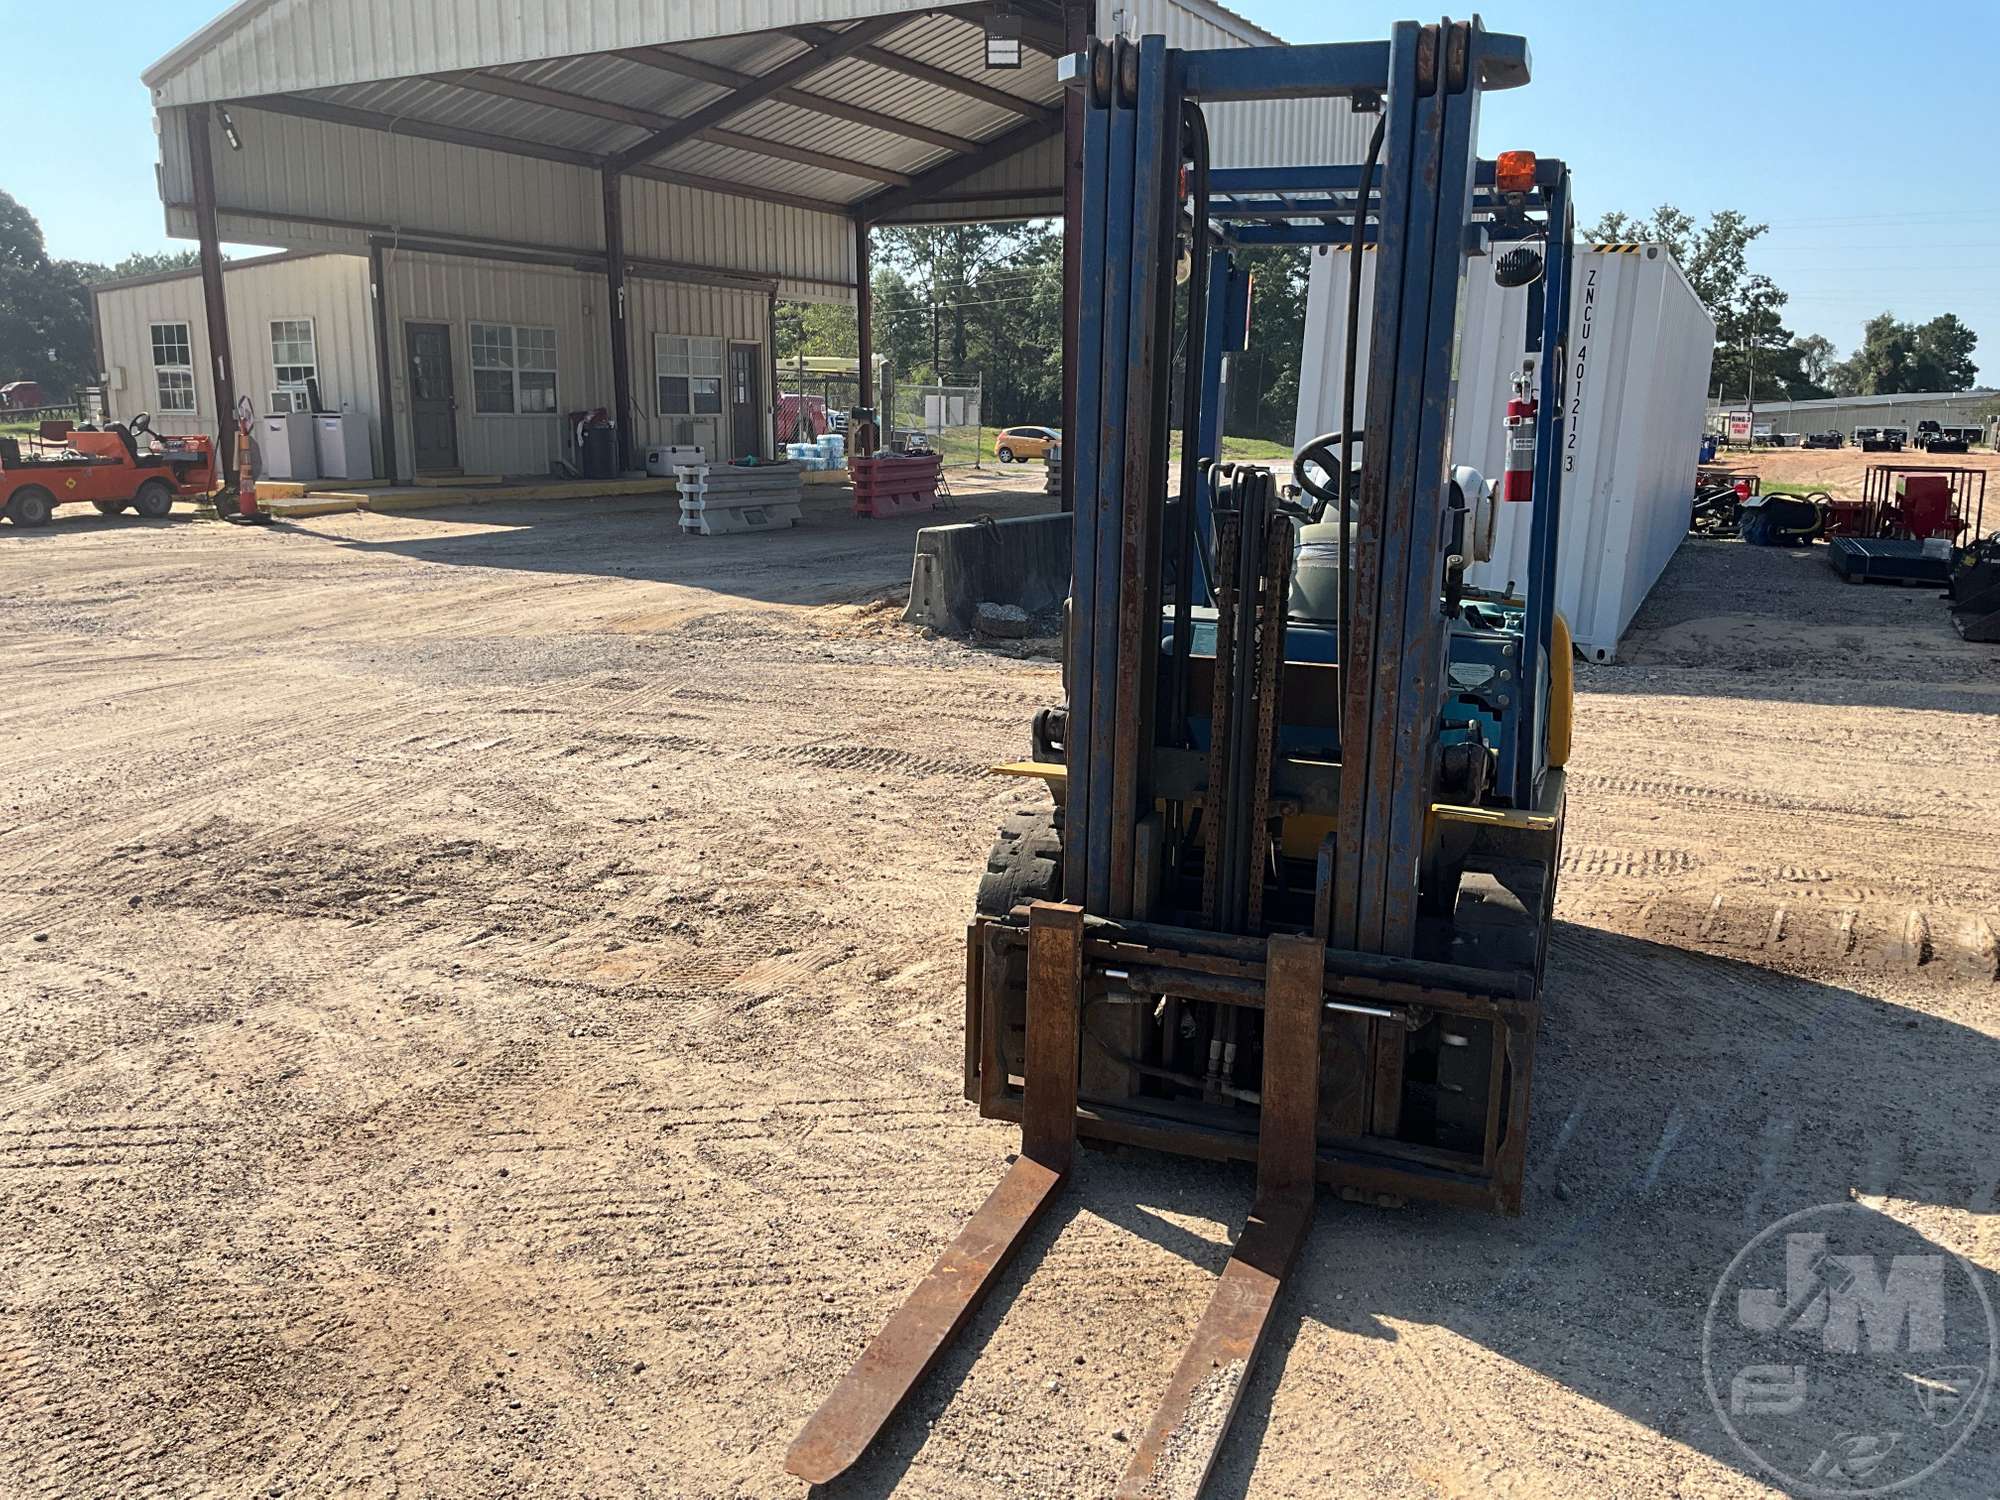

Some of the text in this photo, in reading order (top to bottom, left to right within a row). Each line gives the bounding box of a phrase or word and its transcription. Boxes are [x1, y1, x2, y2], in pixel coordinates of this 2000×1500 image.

[1565, 270, 1597, 472] ZNCU 401212 3
